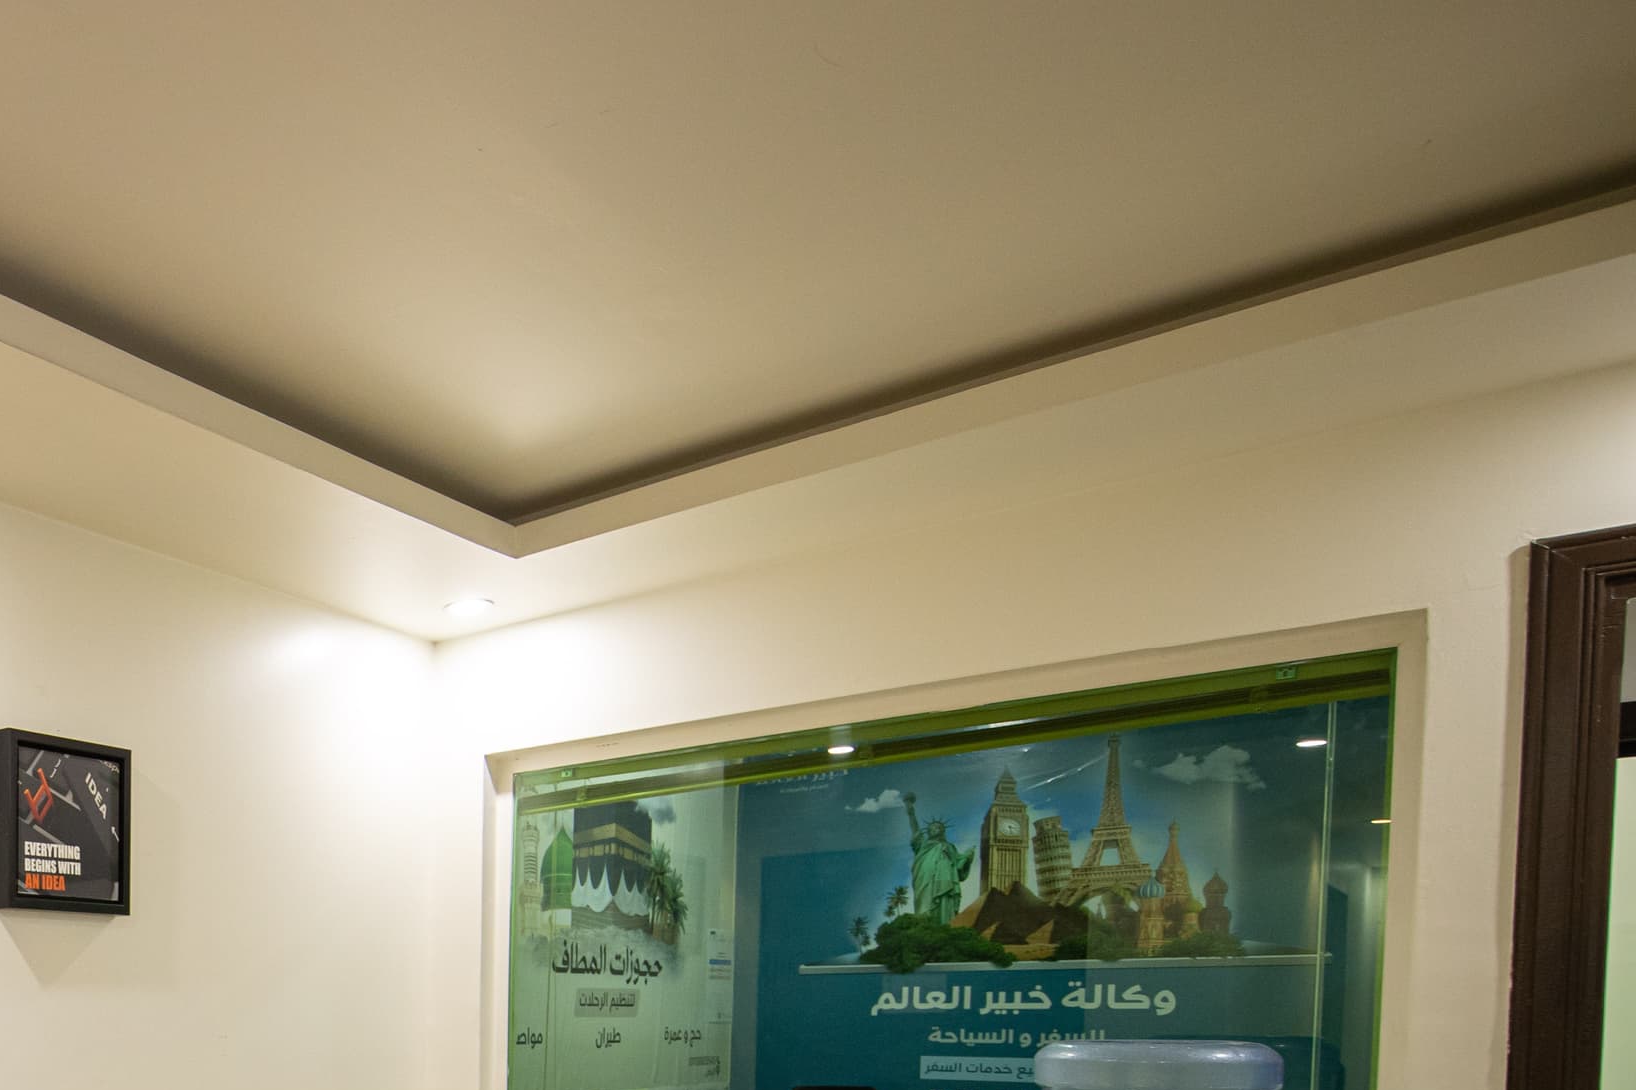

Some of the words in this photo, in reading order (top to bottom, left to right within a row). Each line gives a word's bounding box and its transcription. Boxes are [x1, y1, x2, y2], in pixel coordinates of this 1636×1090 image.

[84, 772, 107, 819] IDEA
[24, 841, 80, 859] EVERYTHING
[24, 858, 57, 873] BEGINS
[58, 861, 80, 875] WITH
[24, 874, 40, 889] AN
[41, 875, 65, 890] IDEA
[552, 939, 606, 977] المطاف
[609, 947, 662, 984] حجوزات
[870, 985, 971, 1015] العالم
[979, 982, 1052, 1015] خبير
[1061, 981, 1176, 1015] وكالة
[595, 1026, 620, 1048] طيران
[927, 1025, 1013, 1044] السياحة
[1019, 1031, 1031, 1047] و
[924, 1062, 961, 1075] السفر
[965, 1063, 1013, 1075] خدمات
